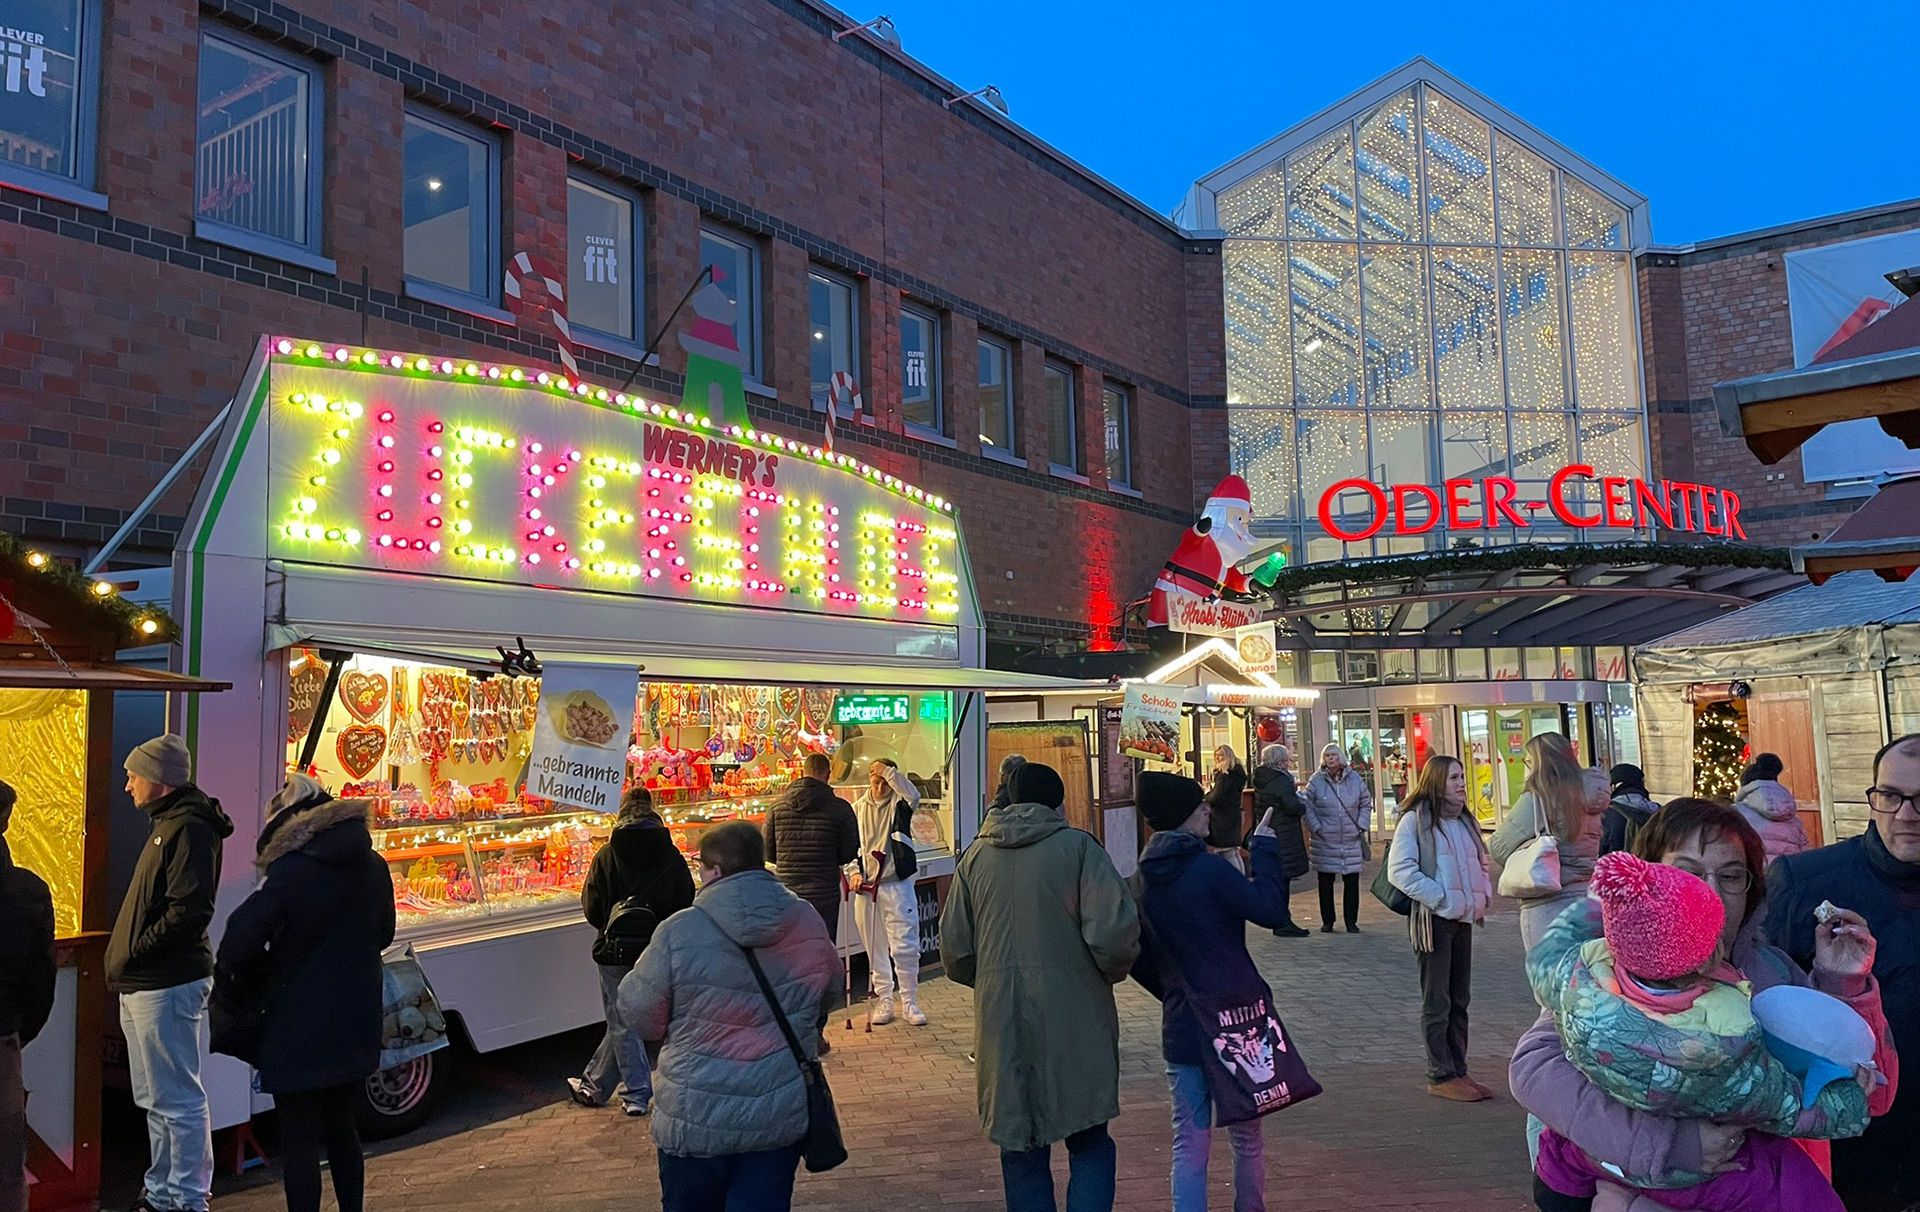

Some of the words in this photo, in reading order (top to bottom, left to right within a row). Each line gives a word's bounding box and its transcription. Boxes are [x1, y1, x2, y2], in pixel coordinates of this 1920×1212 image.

[0, 40, 48, 97] it
[585, 235, 615, 247] CLEVER
[583, 245, 618, 285] fit
[906, 358, 927, 387] fit
[643, 422, 779, 488] WERNER'S
[284, 388, 960, 614] ZUCKERSCHLOSS
[1318, 463, 1748, 542] ODER-CENTER
[1141, 693, 1178, 710] Schoko
[538, 774, 606, 806] Mandeln
[1253, 1081, 1290, 1106] DENIM
